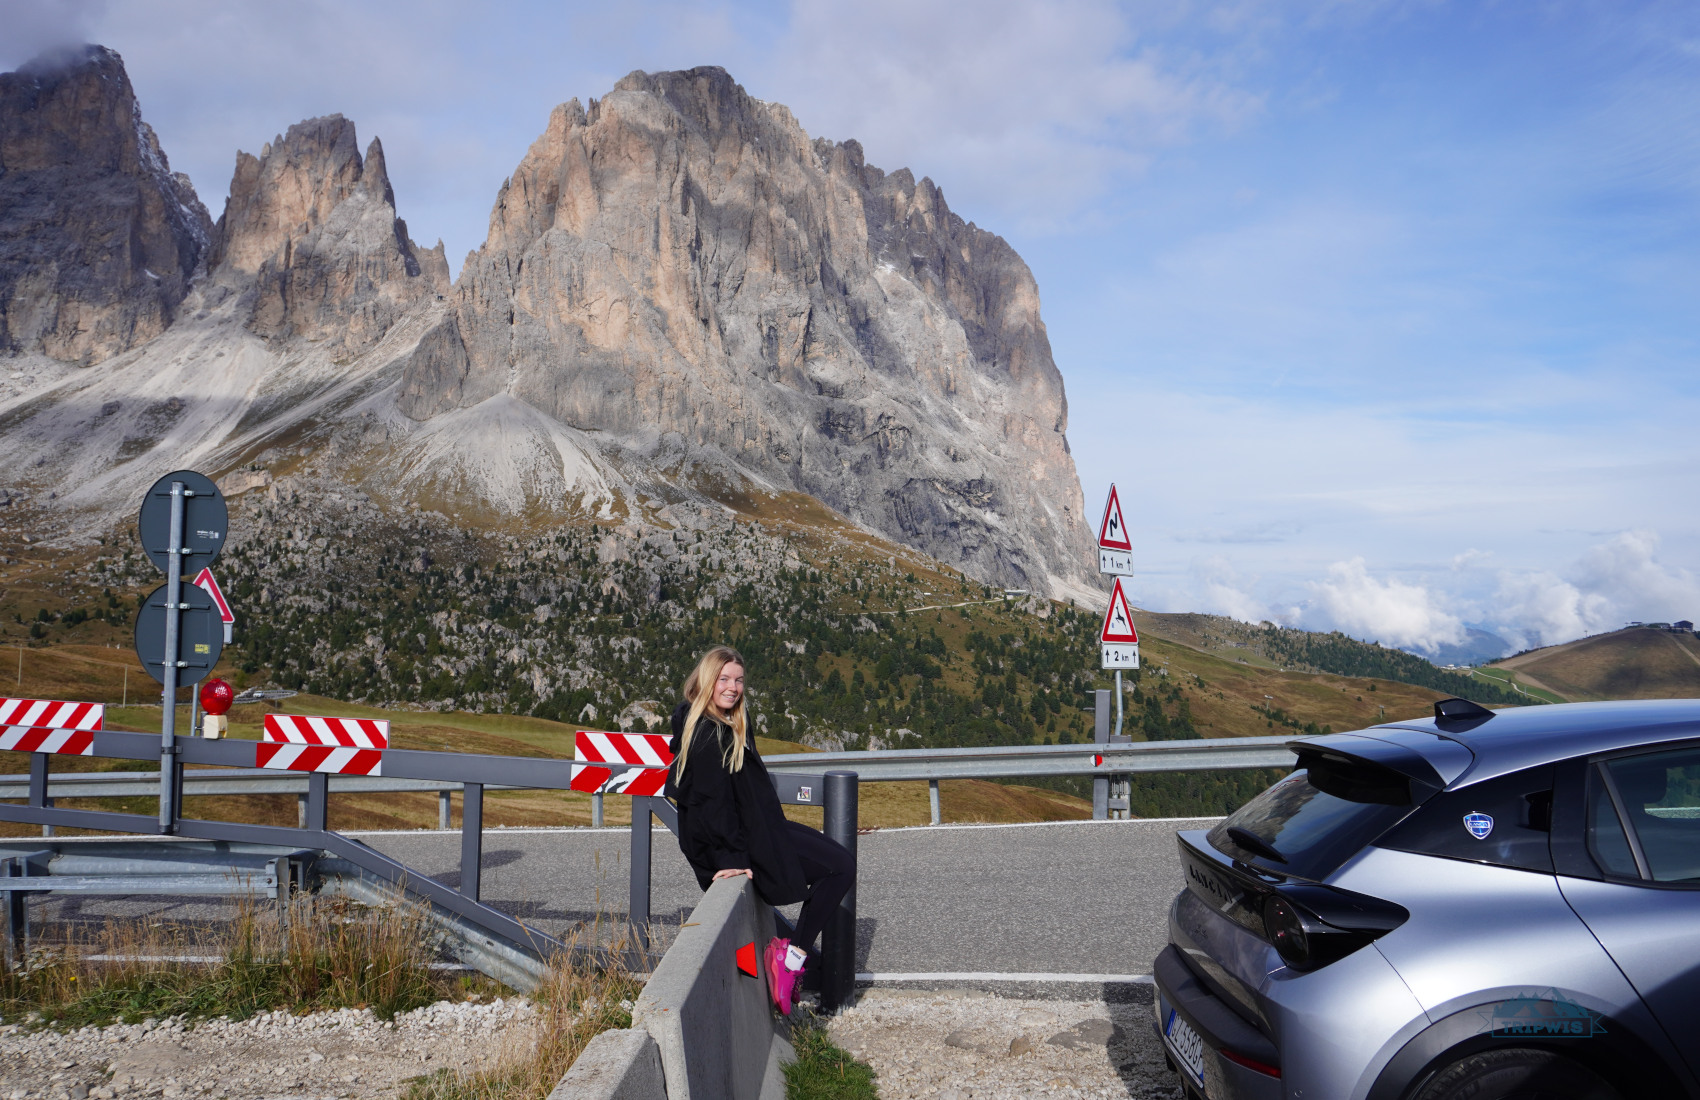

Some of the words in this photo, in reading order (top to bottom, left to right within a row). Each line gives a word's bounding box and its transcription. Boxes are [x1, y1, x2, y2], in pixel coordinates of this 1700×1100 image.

[1116, 561, 1123, 569] km
[1114, 651, 1119, 662] 2
[1121, 653, 1129, 662] km
